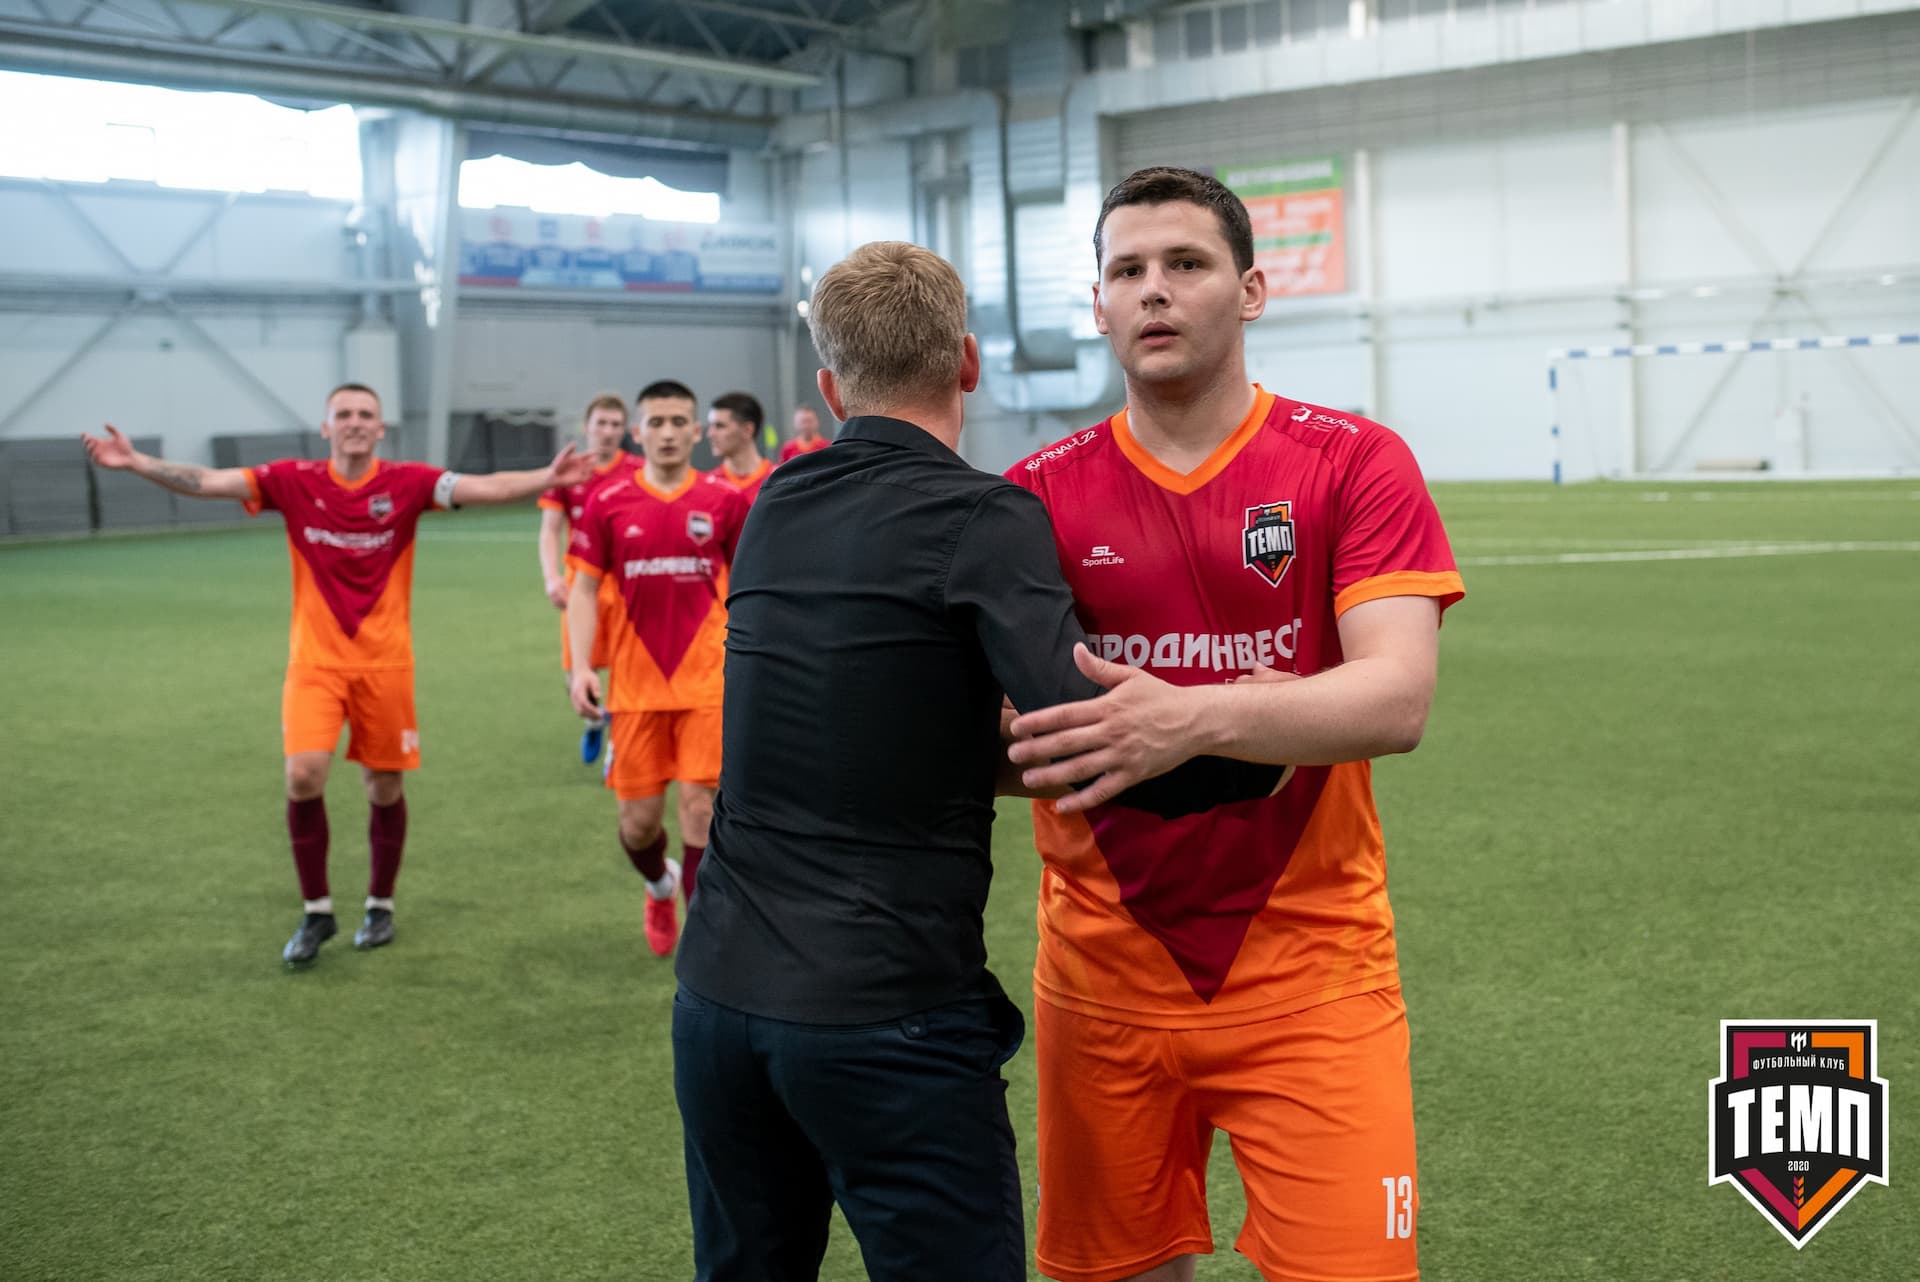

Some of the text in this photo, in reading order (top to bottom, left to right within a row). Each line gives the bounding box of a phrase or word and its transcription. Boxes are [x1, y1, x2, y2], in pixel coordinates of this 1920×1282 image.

[1091, 545, 1116, 557] SL
[1247, 525, 1293, 557] ТЕМП
[1082, 556, 1125, 567] SportLife
[1382, 1175, 1413, 1239] 13
